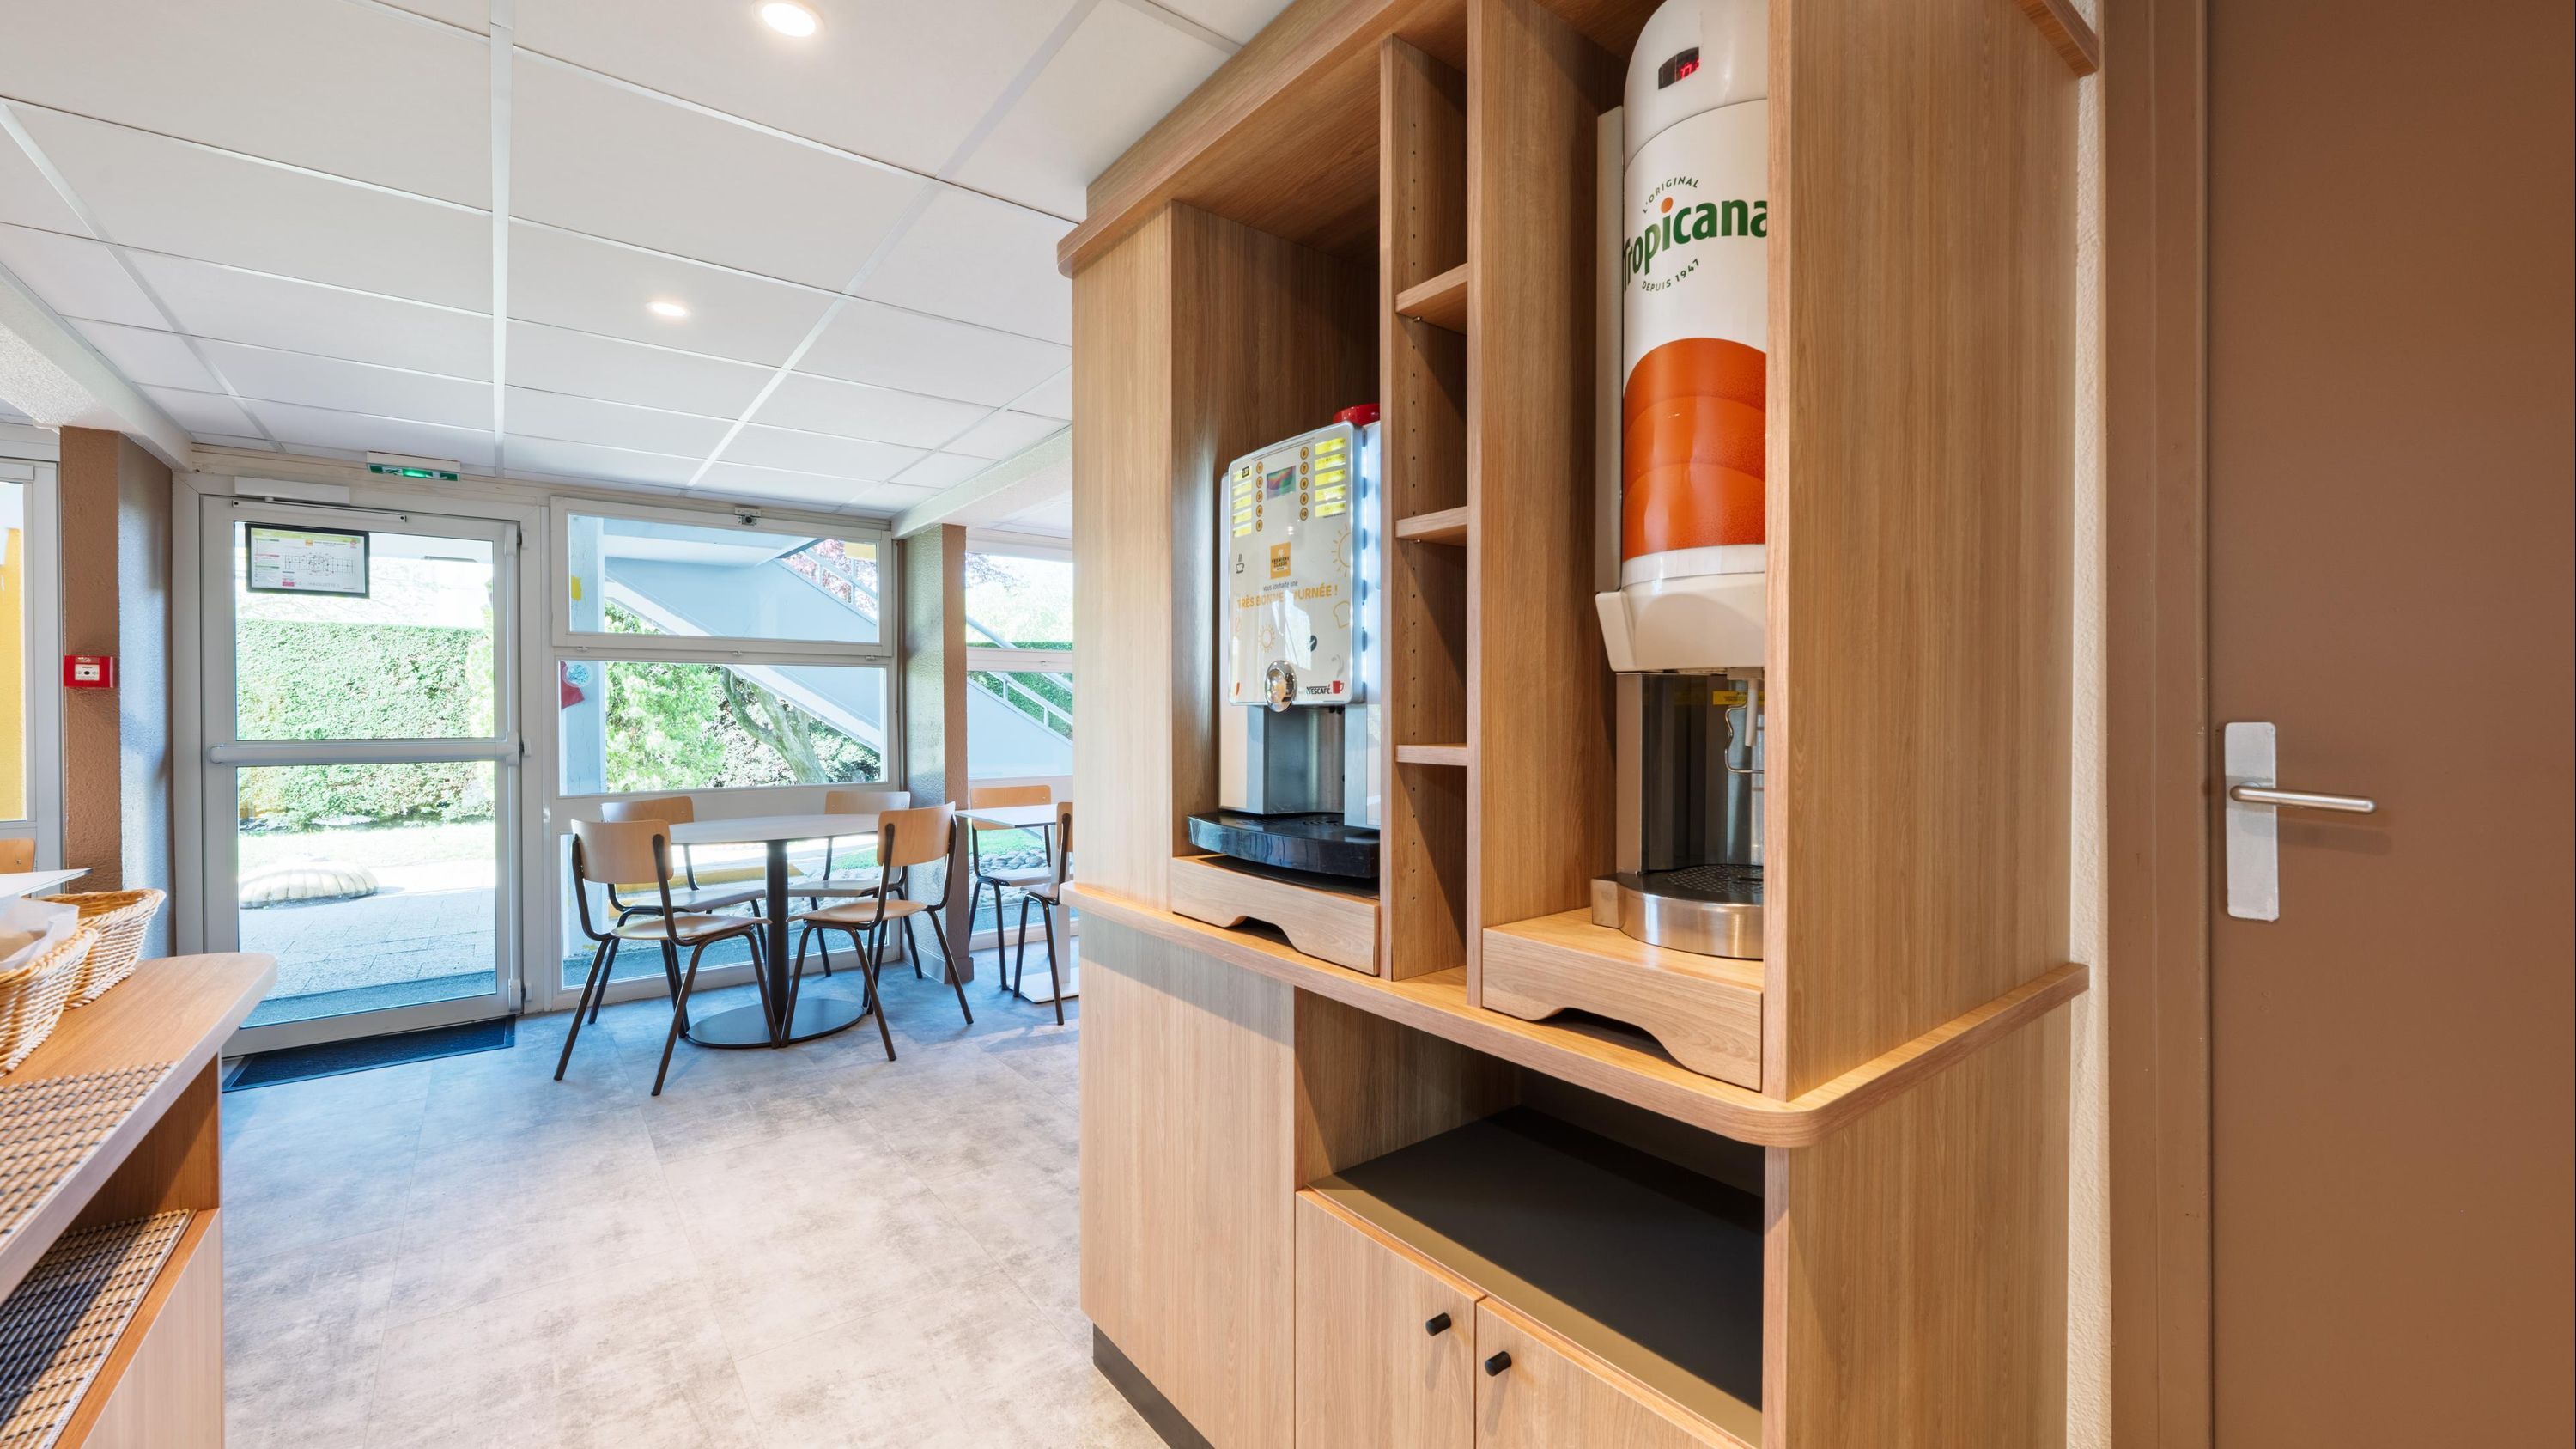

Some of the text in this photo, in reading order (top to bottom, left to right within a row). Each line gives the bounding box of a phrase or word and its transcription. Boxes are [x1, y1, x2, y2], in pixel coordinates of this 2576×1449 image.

[1643, 176, 1699, 214] L'ORIGINAL
[1642, 259, 1699, 292] DEPUIS 1947
[1237, 594, 1254, 608] TRÈS
